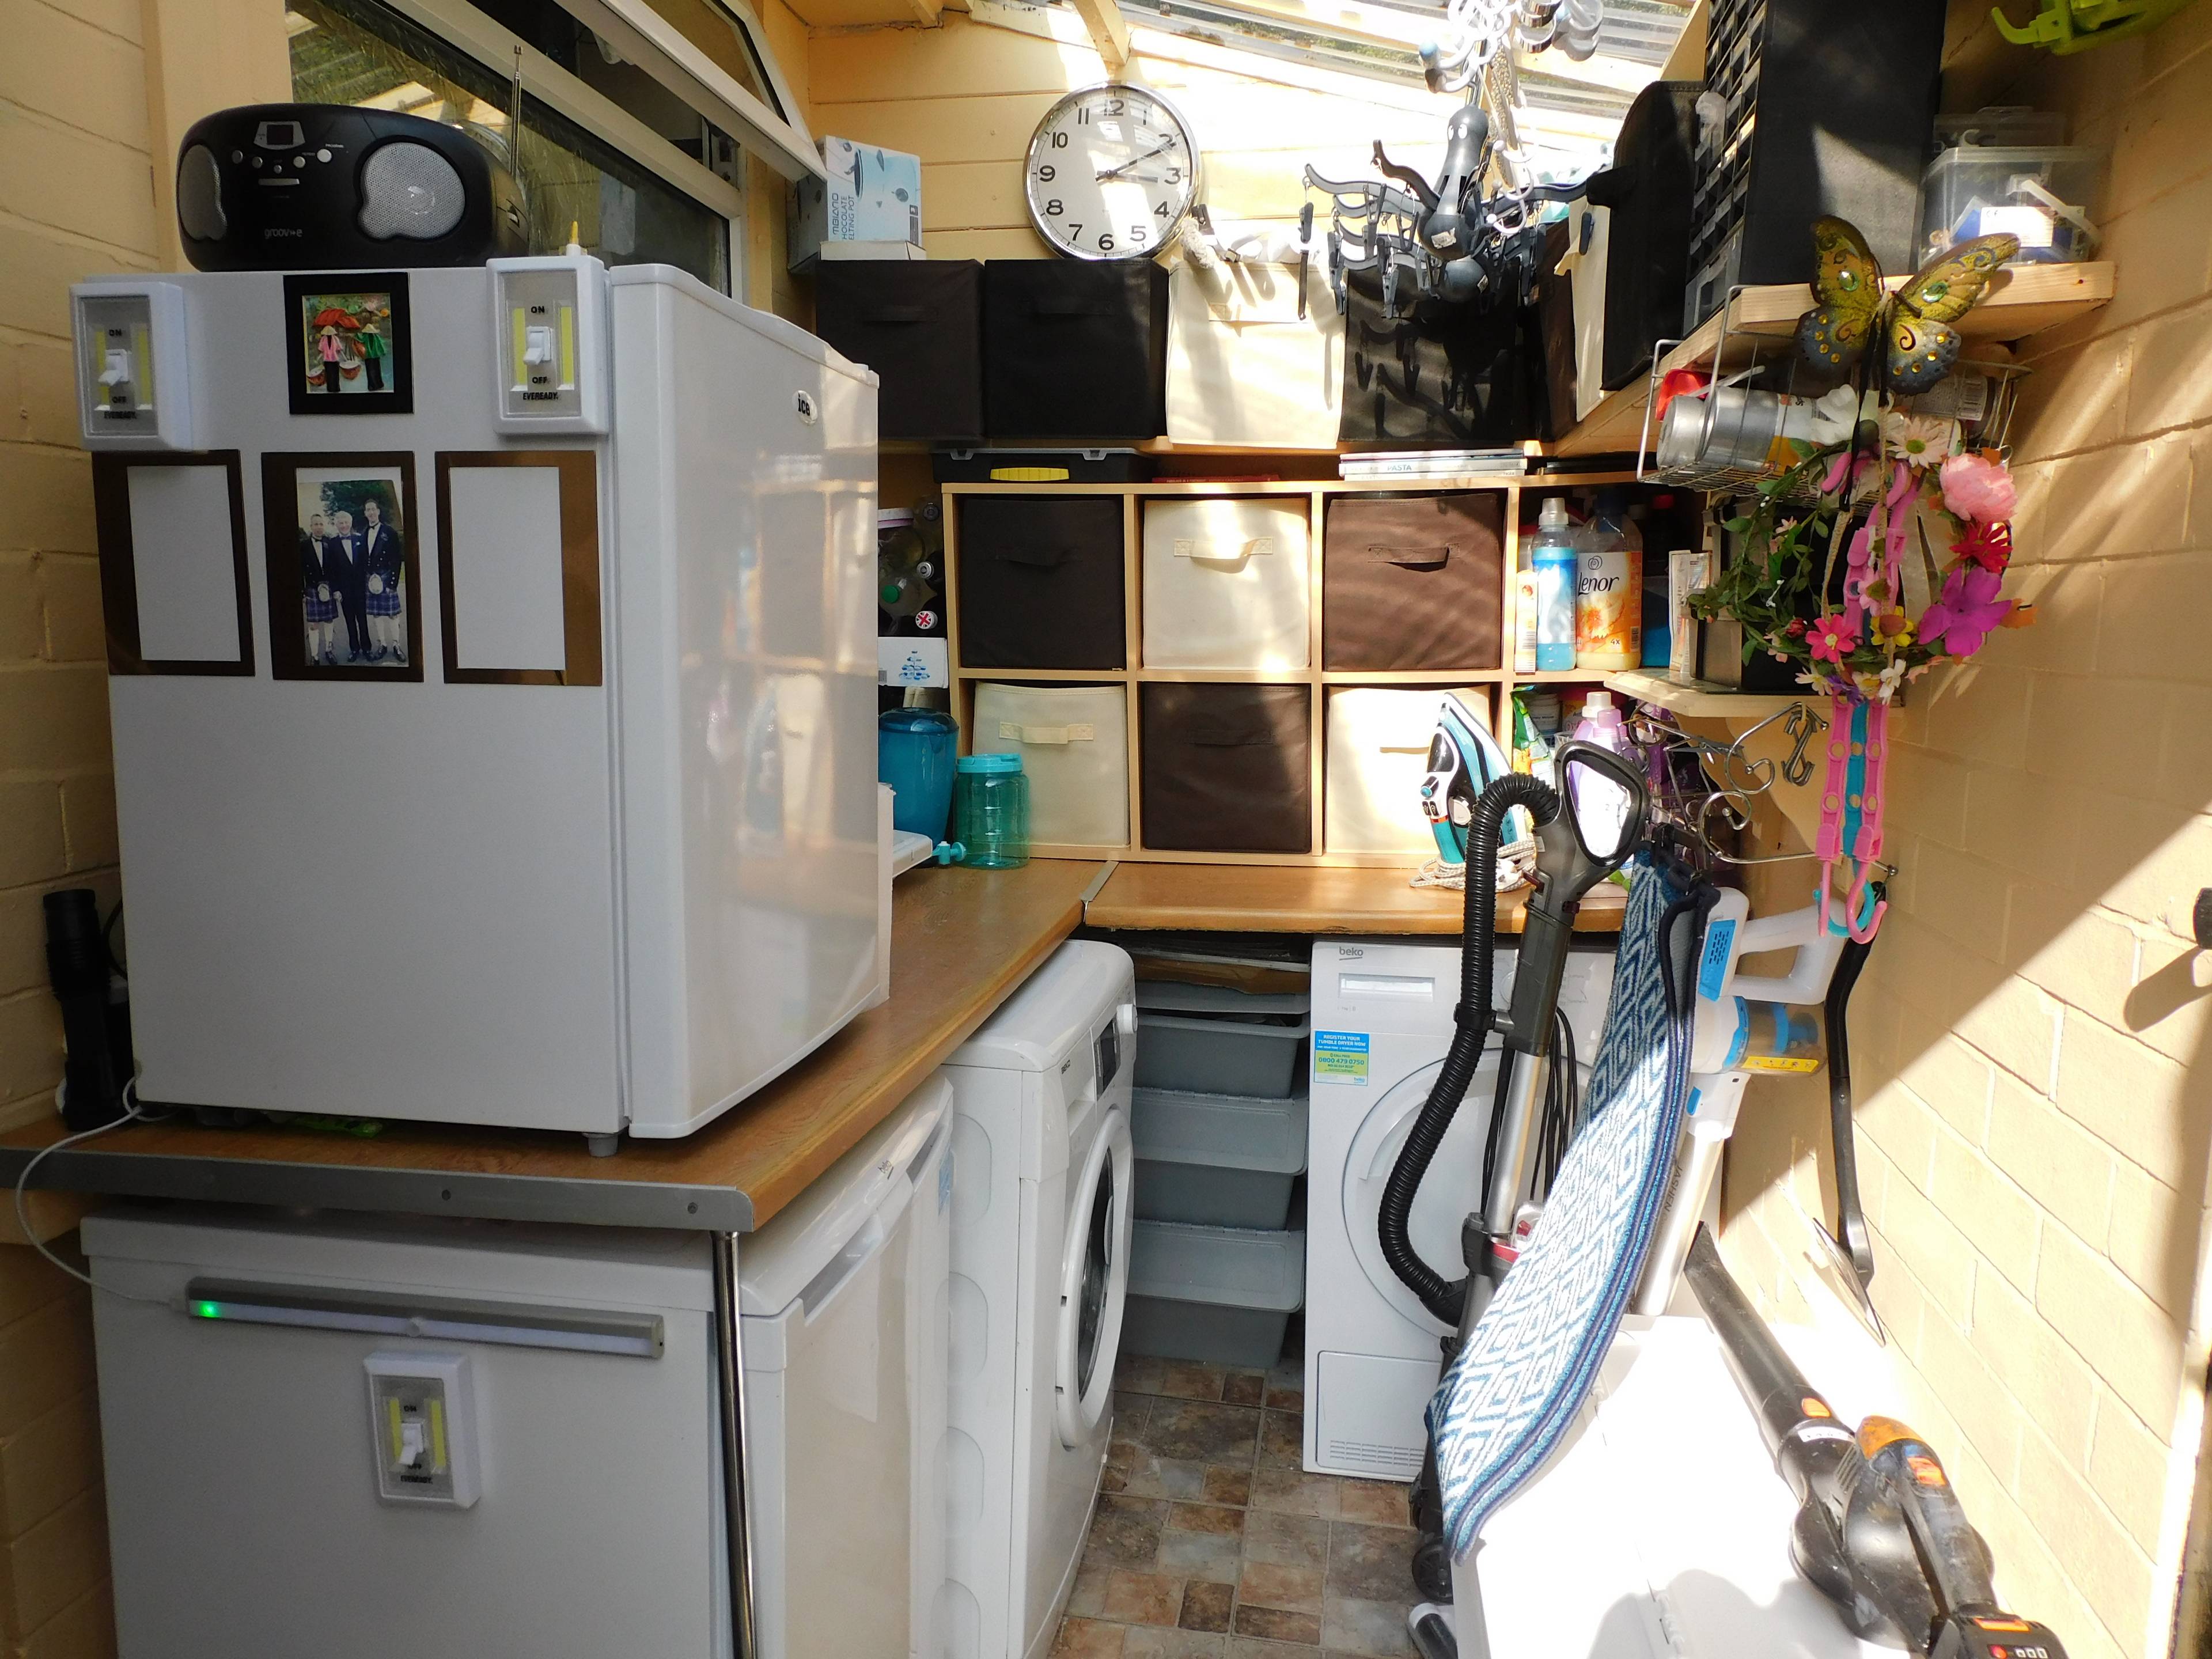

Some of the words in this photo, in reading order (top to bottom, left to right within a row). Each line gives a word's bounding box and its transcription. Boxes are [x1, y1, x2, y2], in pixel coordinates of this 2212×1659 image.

[1078, 108, 1089, 124] 11
[1104, 100, 1124, 116] 12
[1143, 108, 1147, 125] 1
[1052, 132, 1068, 148] 10
[1039, 165, 1055, 182] 9
[1164, 168, 1181, 185] 3
[1046, 199, 1064, 215] 8
[1154, 201, 1169, 218] 4
[1069, 224, 1082, 241] 7
[1129, 225, 1146, 242] 5
[1099, 234, 1115, 251] 6
[798, 392, 810, 416] ice
[1578, 572, 1619, 596] Lenor
[1339, 946, 1363, 956] beko
